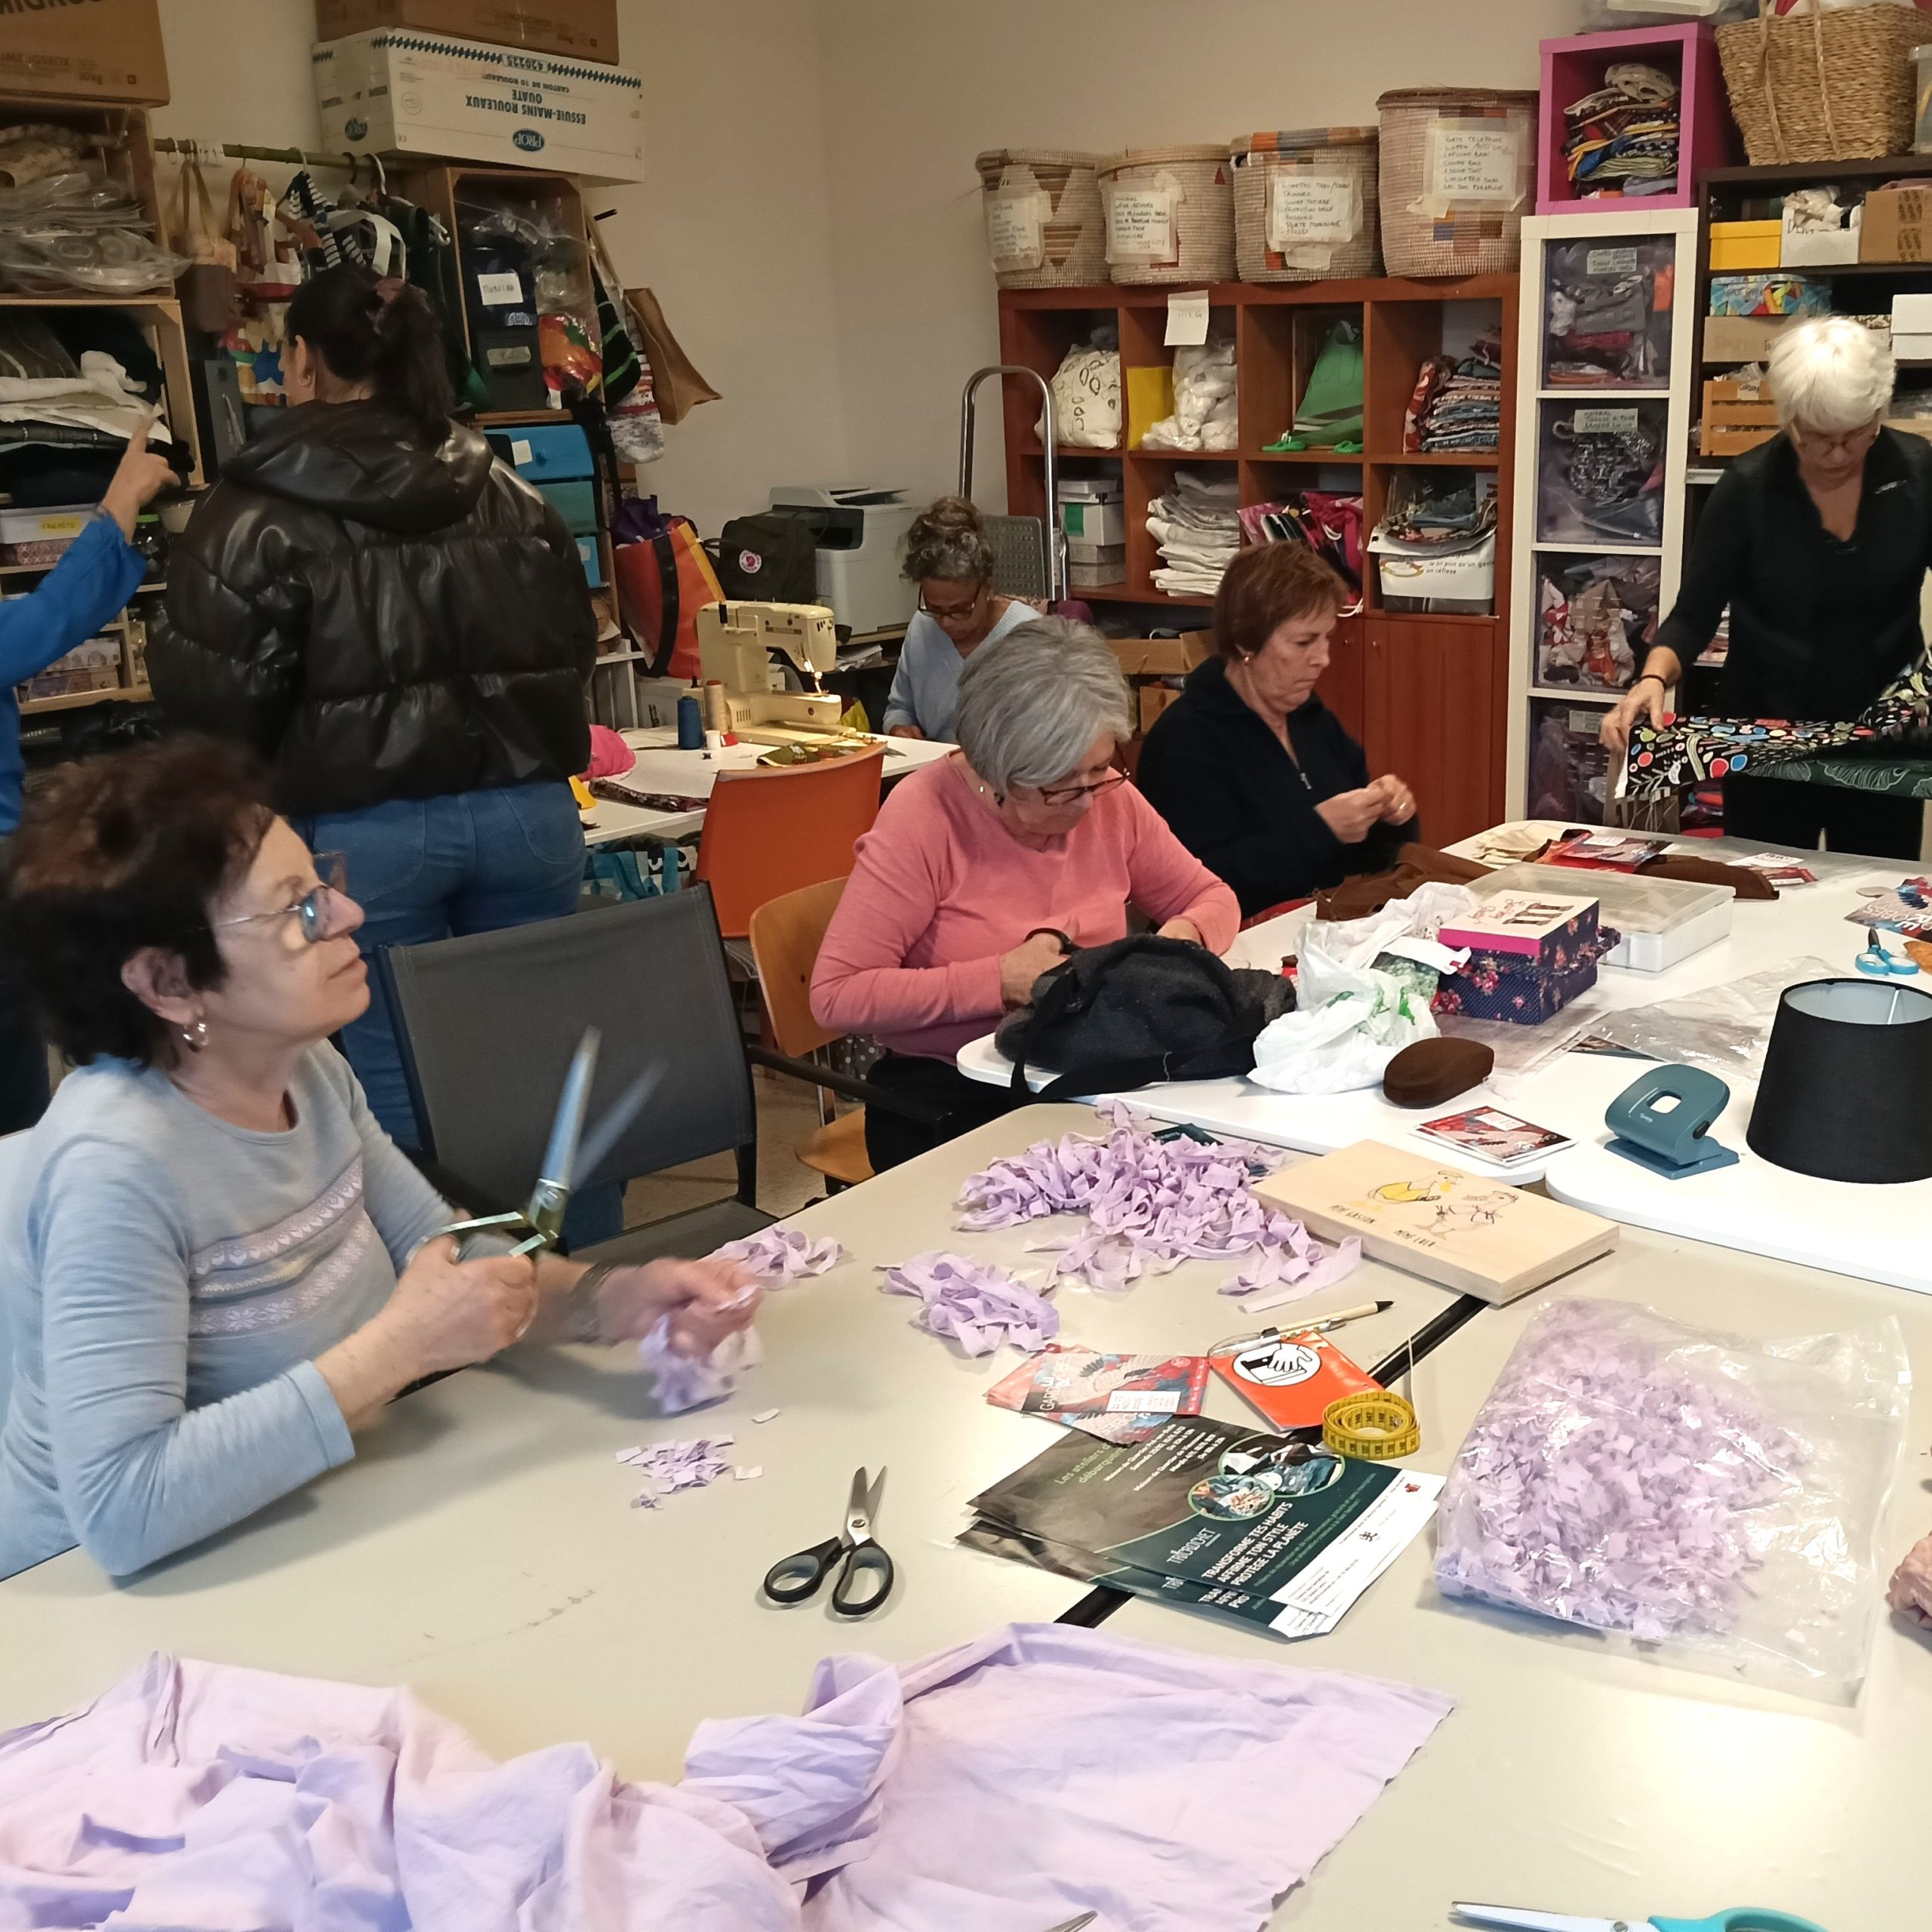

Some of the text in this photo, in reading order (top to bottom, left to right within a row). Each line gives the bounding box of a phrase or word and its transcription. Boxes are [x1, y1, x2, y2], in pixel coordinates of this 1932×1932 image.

[506, 55, 544, 72] 420225
[531, 82, 541, 90] DE
[542, 83, 571, 93] CARTON
[512, 89, 543, 104] OUATE
[466, 94, 586, 125] ESSUIE-MAINS ROULEAUX
[514, 132, 545, 149] PROP
[1054, 1472, 1074, 1484] Les
[1201, 1537, 1254, 1577] TRANSFORME
[1248, 1524, 1267, 1537] TES
[1262, 1502, 1292, 1525] HABITS
[1217, 1523, 1288, 1582] AFFIRME TON STYLE
[1230, 1558, 1269, 1585] PROTÈGE
[1263, 1549, 1278, 1558] LA
[1272, 1521, 1308, 1549] PLANÈTE
